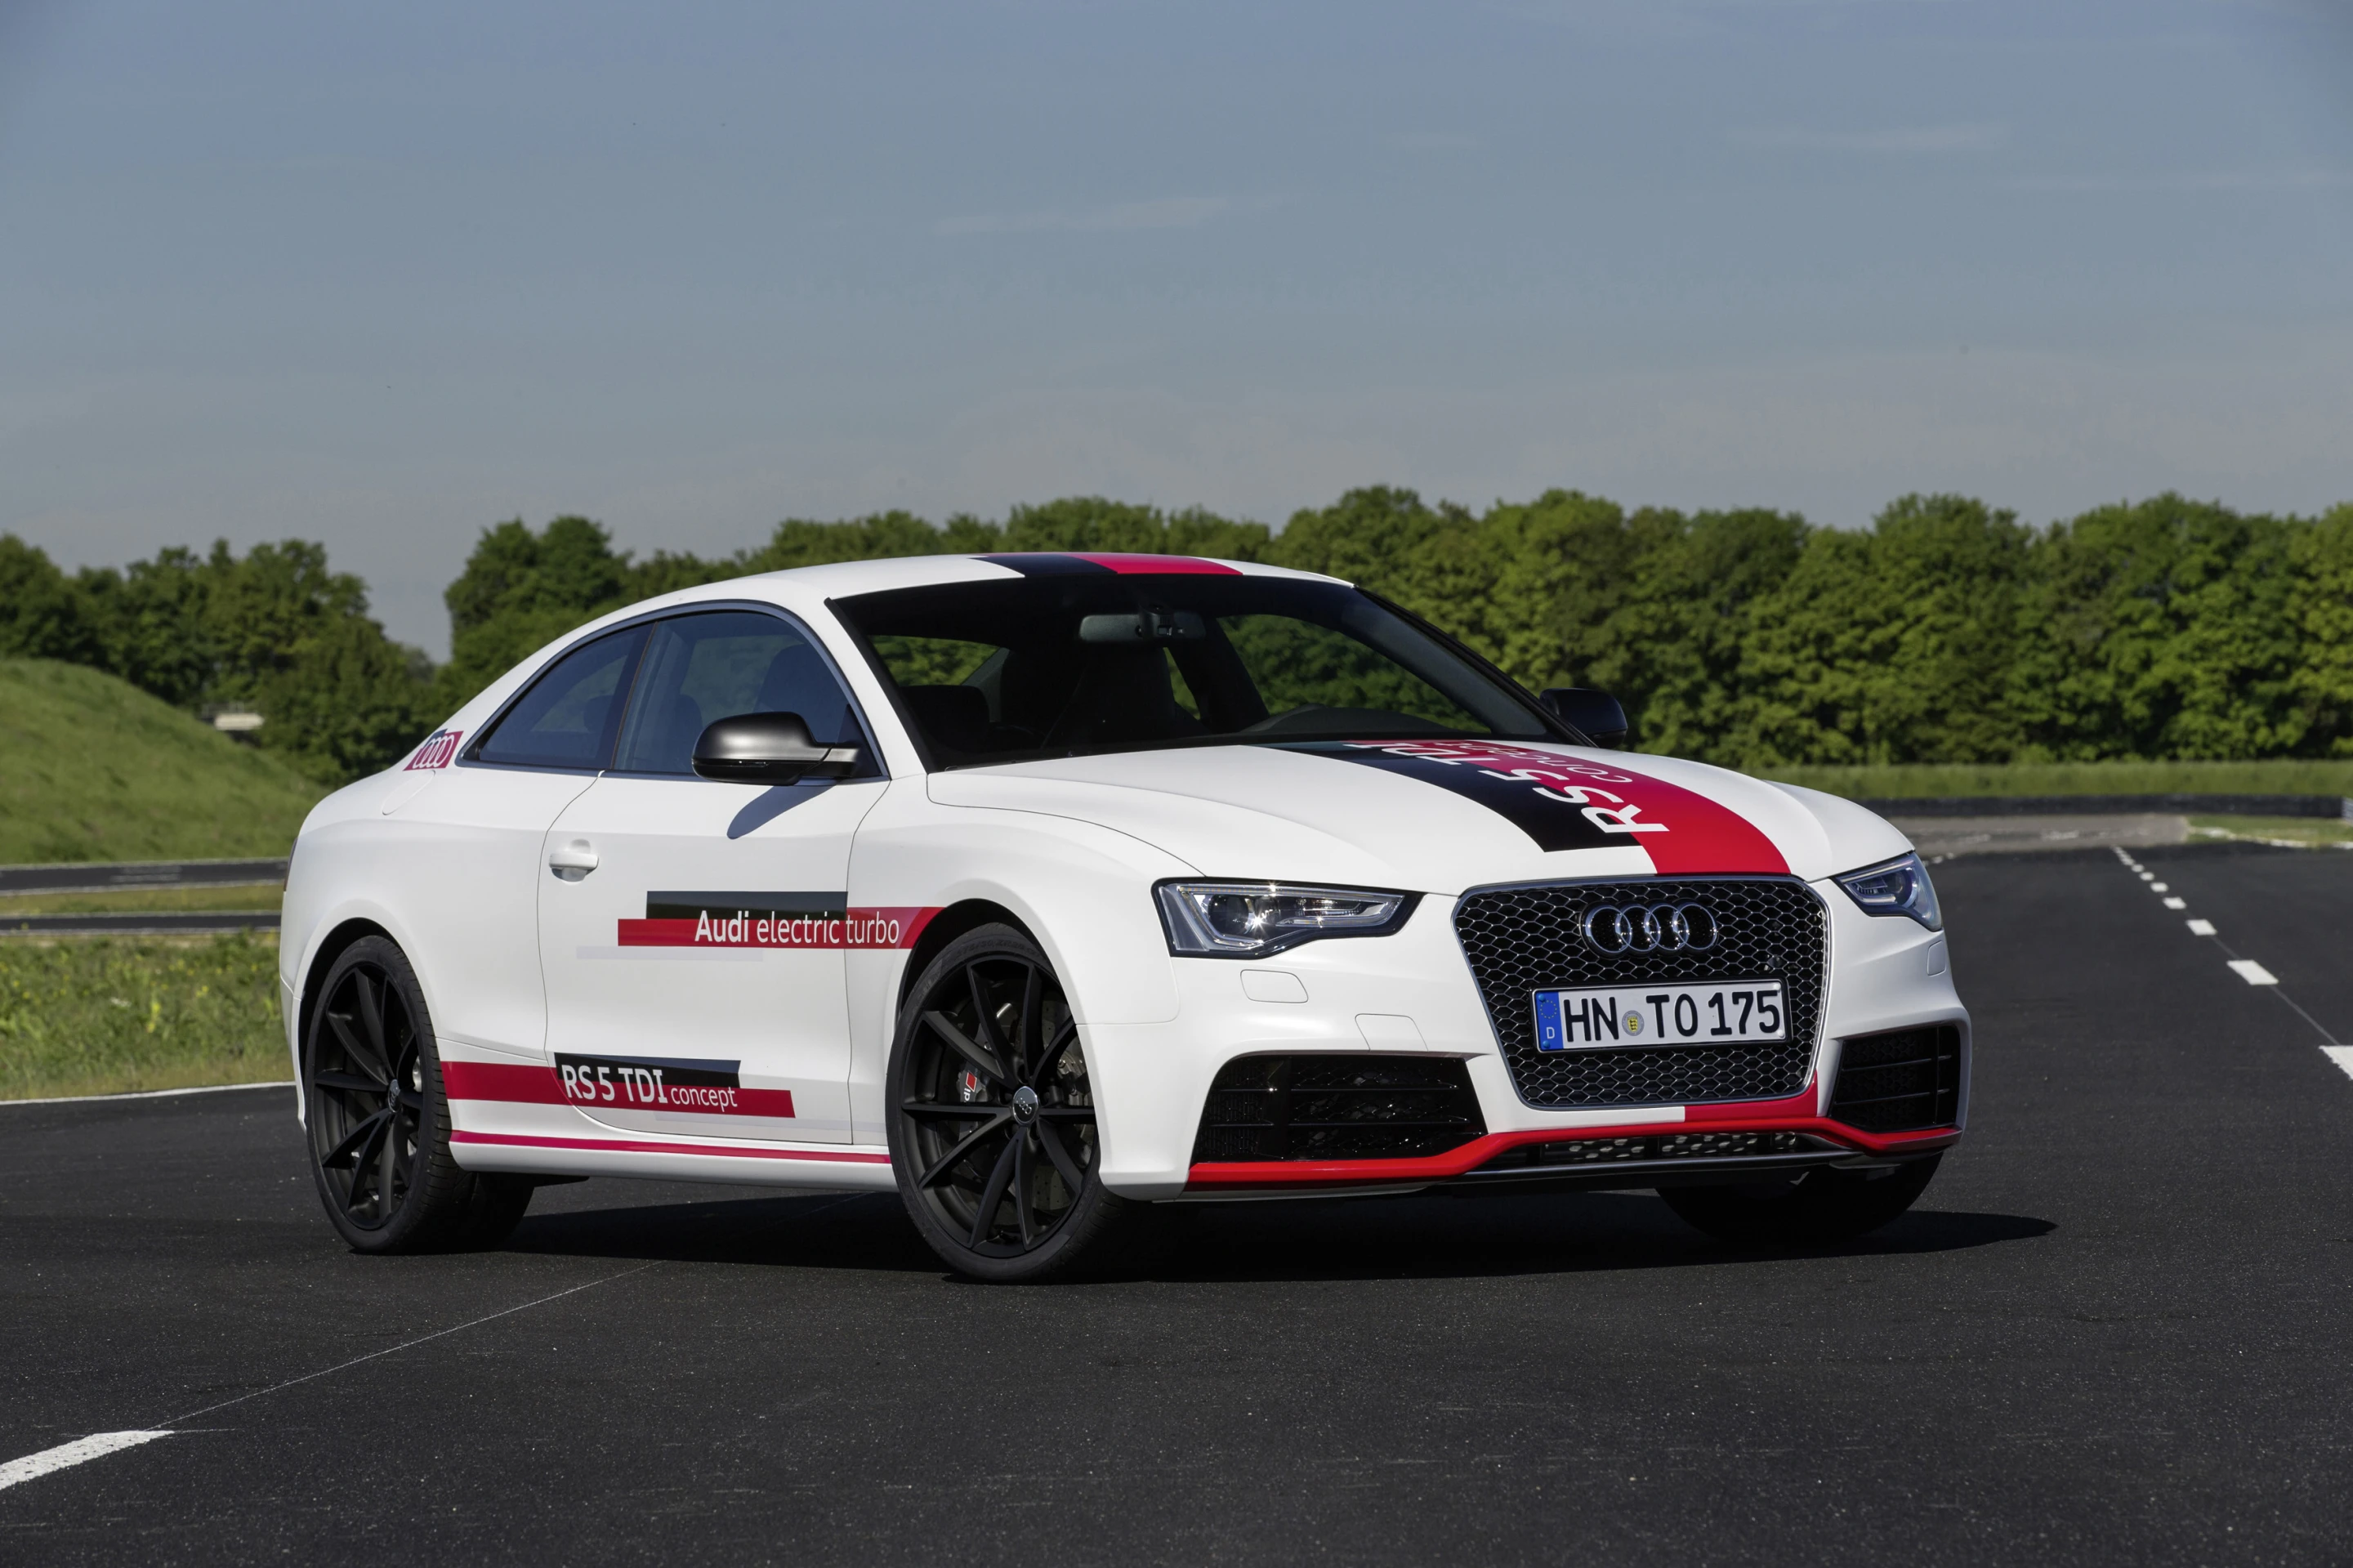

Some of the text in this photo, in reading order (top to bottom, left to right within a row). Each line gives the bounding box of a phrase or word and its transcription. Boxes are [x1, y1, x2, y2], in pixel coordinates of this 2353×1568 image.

[1434, 742, 1633, 783] concept
[1342, 742, 1670, 833] RS 5 TDI
[694, 909, 900, 944] Audi electric turbo
[1546, 1026, 1556, 1039] D
[1563, 989, 1780, 1043] HN TO 175
[561, 1064, 738, 1113] RS 5 TDI concept
